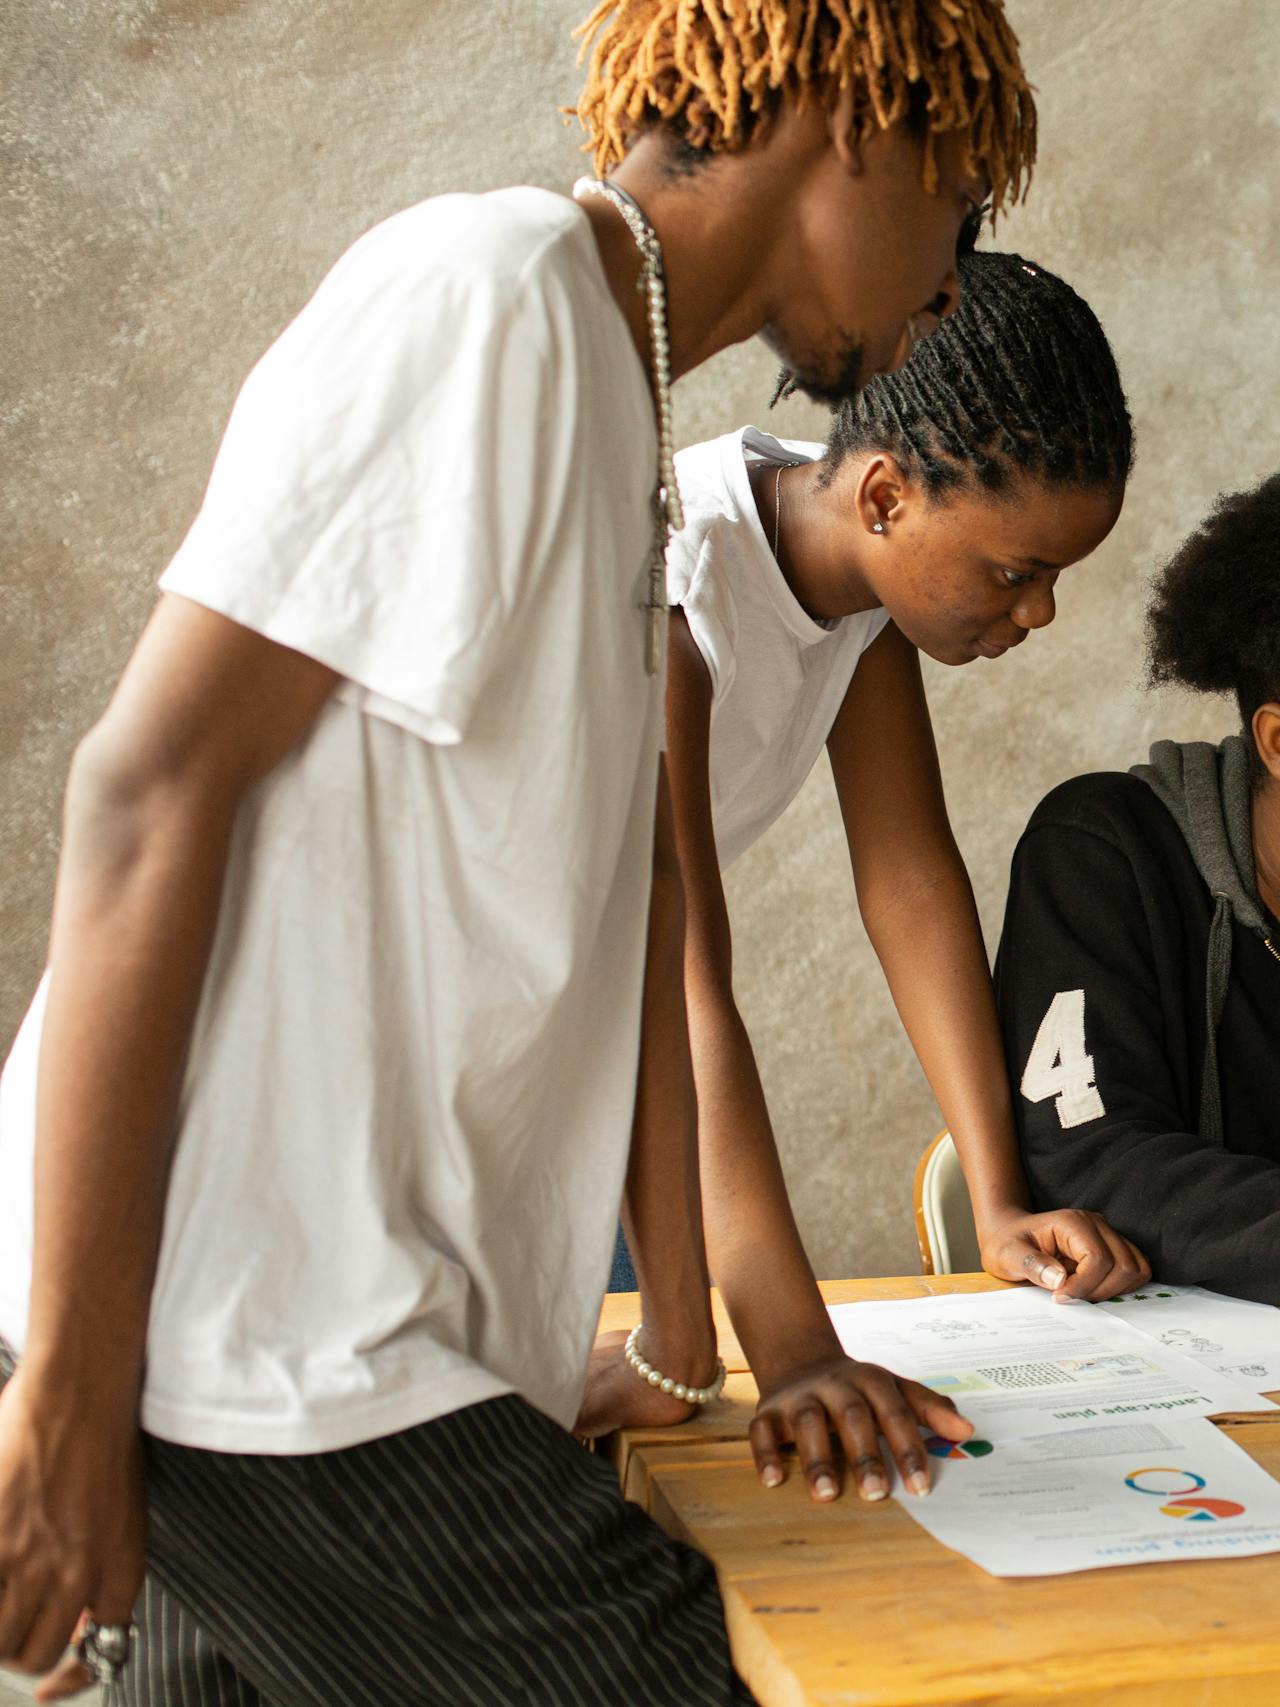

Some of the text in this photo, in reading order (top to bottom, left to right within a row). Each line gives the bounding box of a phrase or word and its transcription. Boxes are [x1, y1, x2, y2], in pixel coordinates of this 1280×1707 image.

[1020, 989, 1106, 1129] 4
[1052, 1408, 1098, 1420] plan
[1102, 1396, 1213, 1414] Landscape
